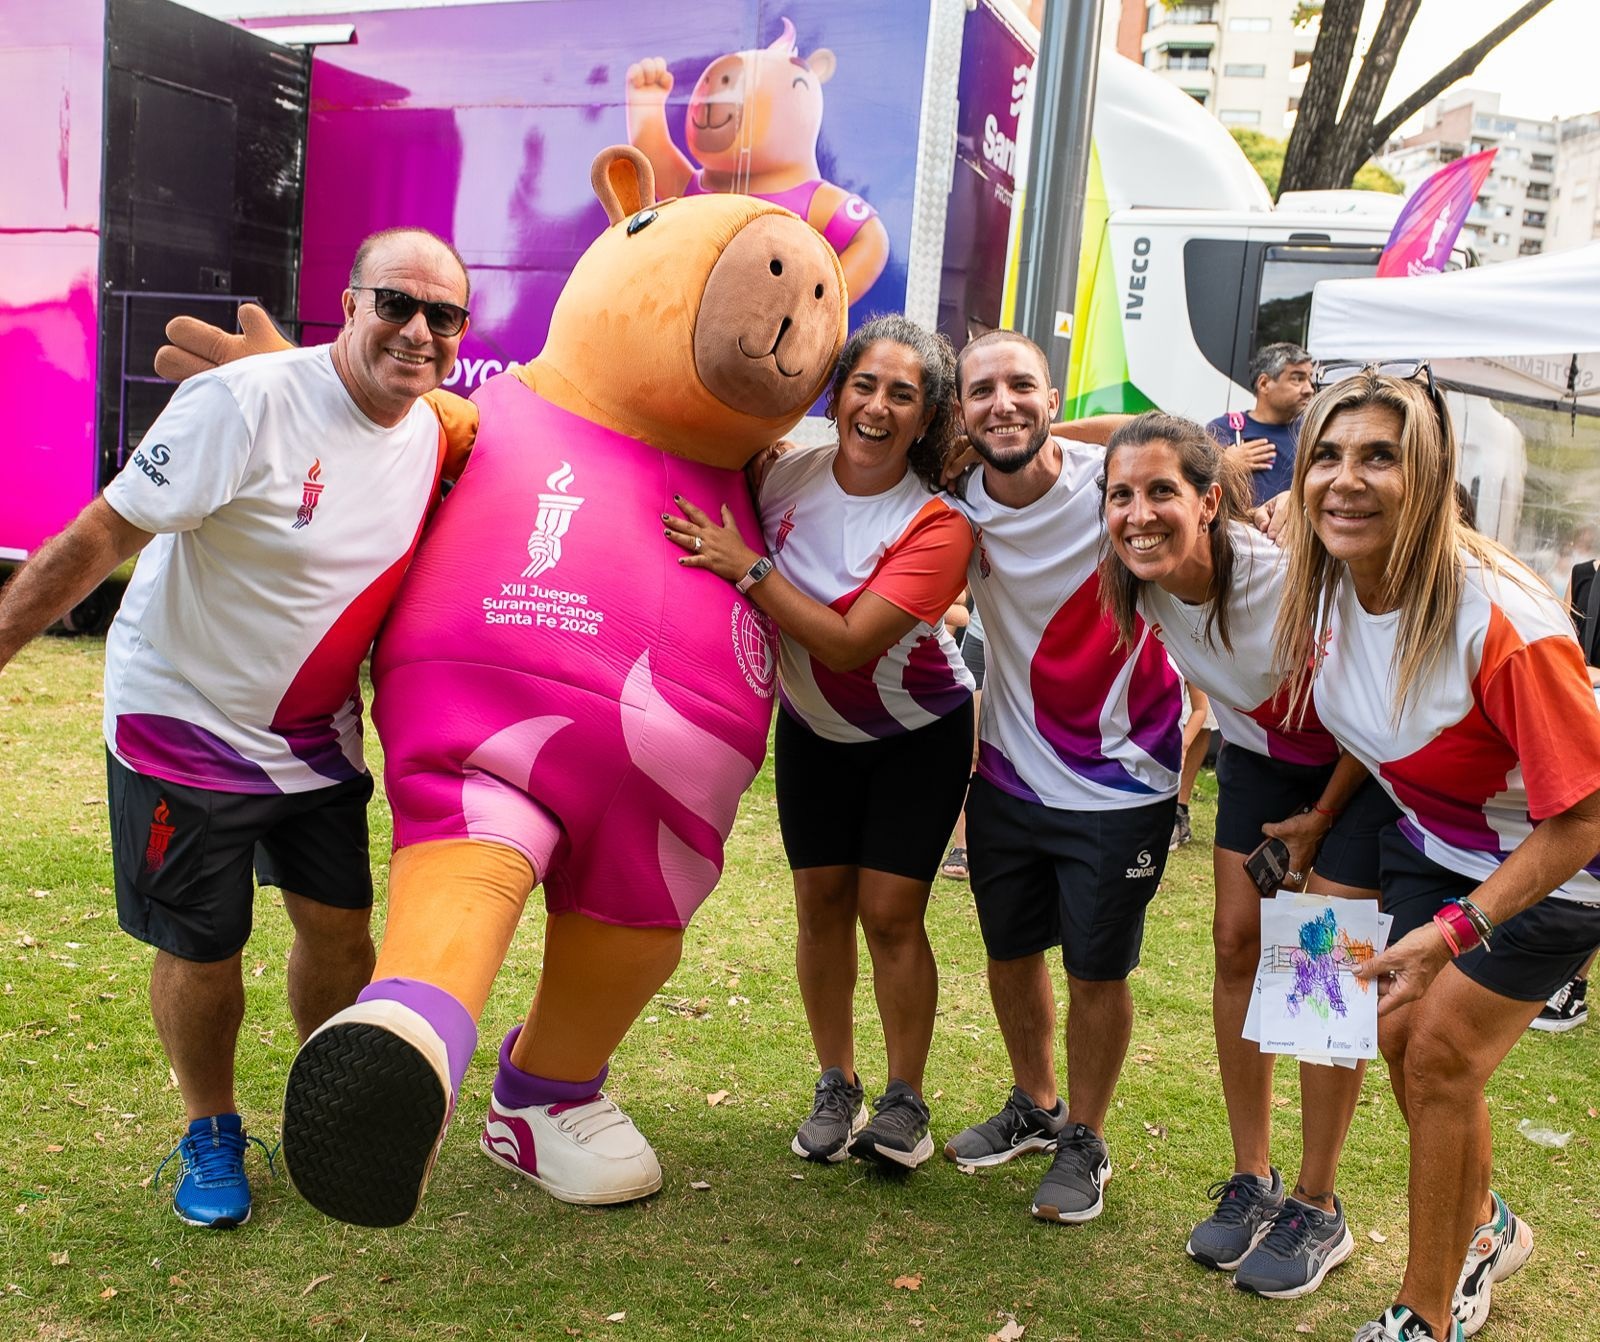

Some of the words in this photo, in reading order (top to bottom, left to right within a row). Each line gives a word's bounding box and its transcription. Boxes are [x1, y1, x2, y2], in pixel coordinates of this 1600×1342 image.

[846, 198, 870, 221] C
[1125, 237, 1151, 320] IVECO
[442, 358, 520, 388] OYC
[500, 583, 527, 597] XIII
[529, 585, 589, 605] Juegos
[482, 597, 604, 623] Suramericanos
[485, 611, 533, 626] Santa
[536, 614, 558, 629] Fe
[560, 617, 599, 635] 2026
